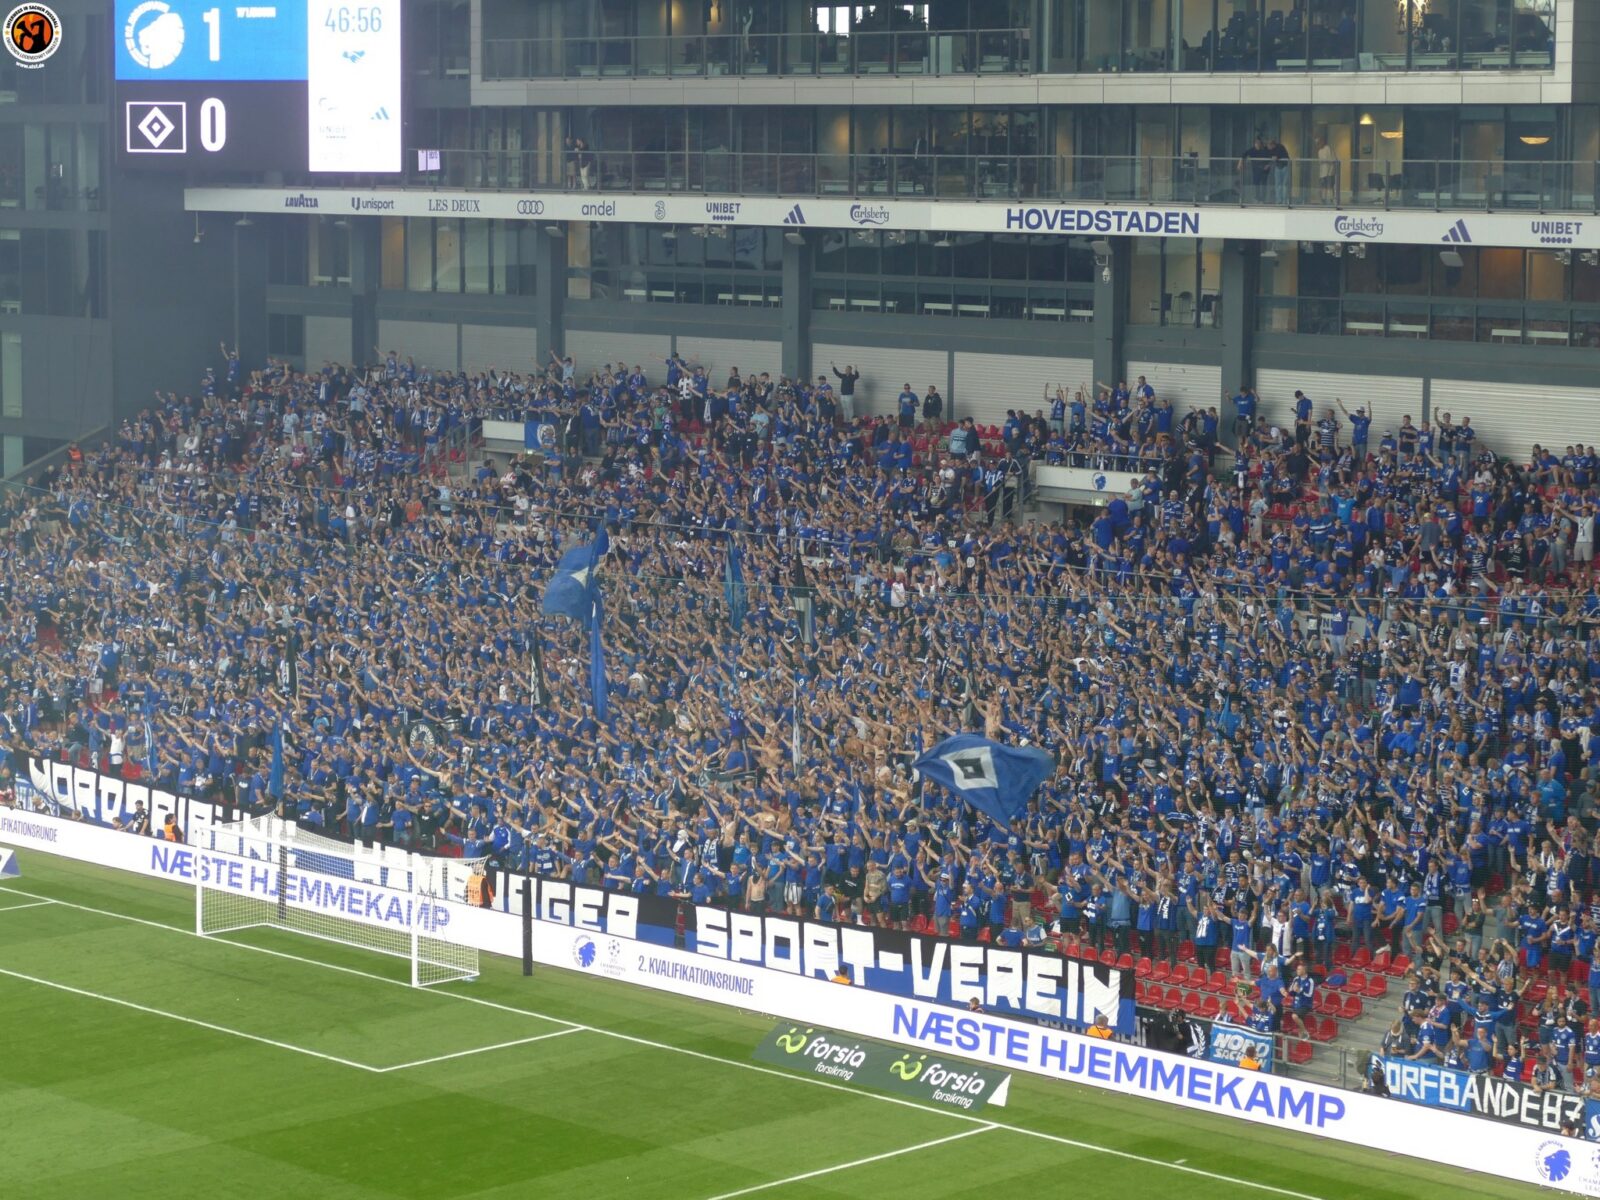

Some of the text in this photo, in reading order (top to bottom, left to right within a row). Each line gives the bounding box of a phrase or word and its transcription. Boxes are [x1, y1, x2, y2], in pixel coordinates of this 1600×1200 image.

[325, 7, 382, 32] 46:56
[203, 8, 220, 61] 1
[200, 98, 226, 151] 0
[285, 194, 318, 208] LAVAZZA
[362, 198, 394, 212] unisport
[428, 199, 480, 212] LES DEUX
[582, 201, 615, 216] andel
[705, 202, 741, 214] UNIBET
[850, 204, 890, 225] Carlsberg
[1007, 208, 1199, 235] HOVEDSTADEN
[1335, 215, 1384, 238] Carlsberg
[1531, 221, 1583, 235] UNIBET
[152, 844, 450, 932] NÆSTE HJEMMEKAMP
[638, 955, 754, 996] 2. KVALIFIKATIONSRUNDE
[695, 905, 1121, 1027] SPORT-VEREIN
[804, 1036, 866, 1069] forsia
[1213, 1048, 1267, 1068] SACHN
[814, 1062, 854, 1082] forsikring
[893, 1004, 1029, 1063] NÆSTE
[1040, 1035, 1345, 1128] HJEMMEKAMP
[920, 1063, 985, 1096] forsia
[932, 1088, 973, 1110] forsikring
